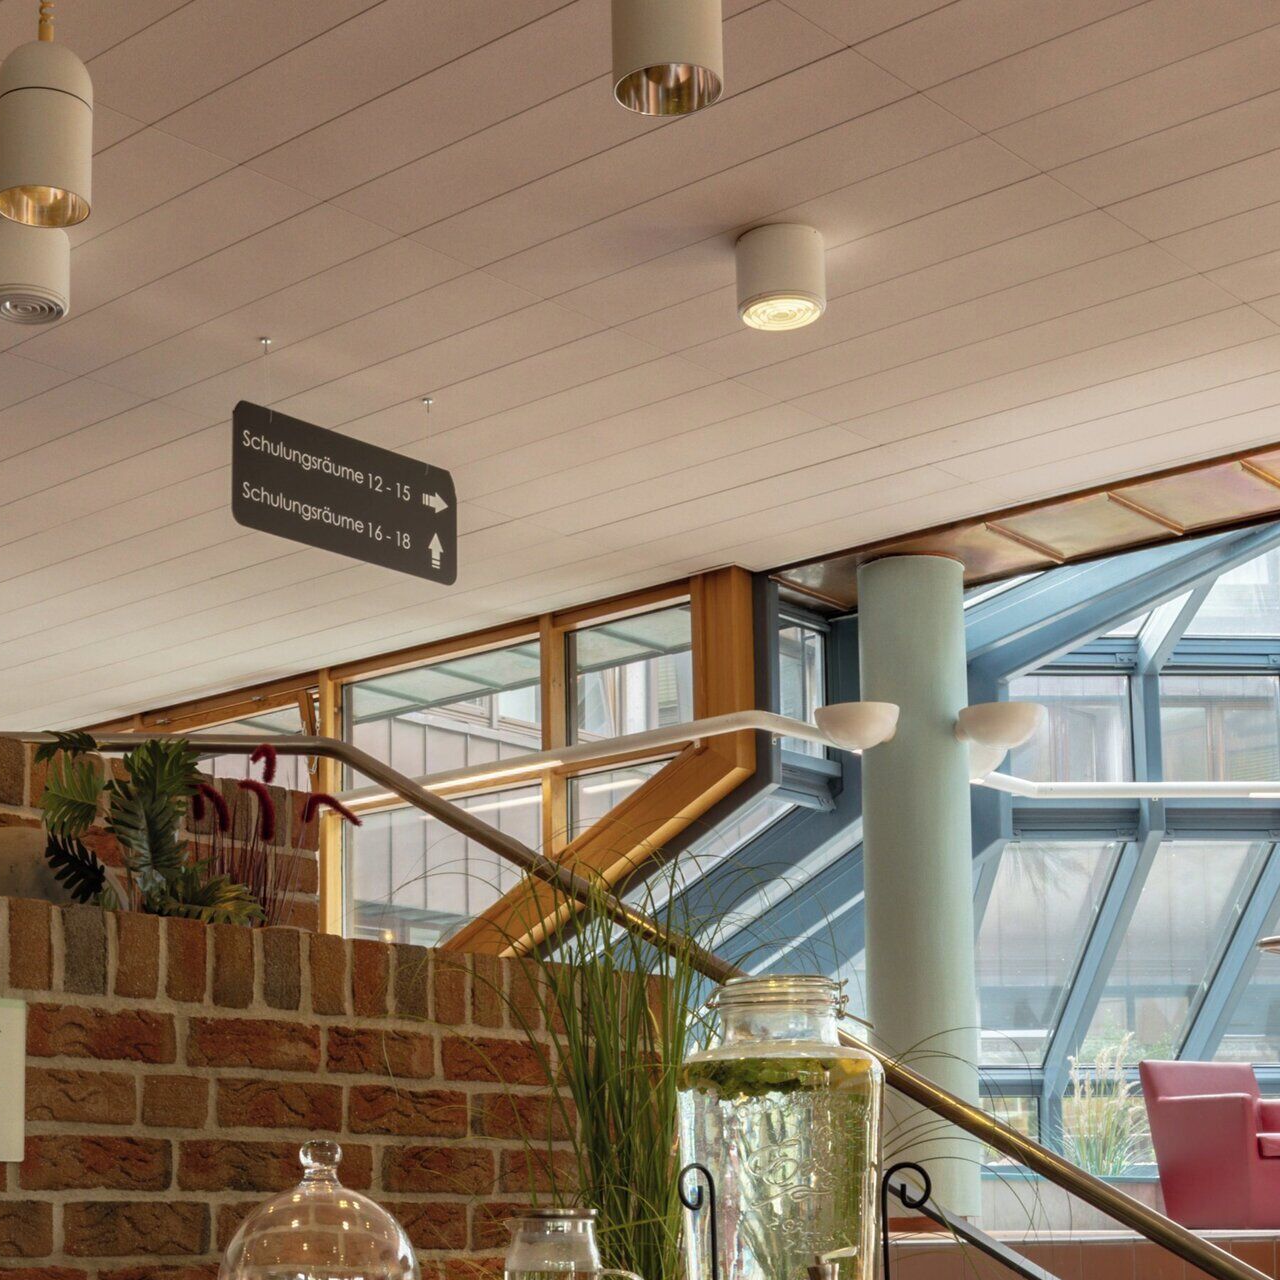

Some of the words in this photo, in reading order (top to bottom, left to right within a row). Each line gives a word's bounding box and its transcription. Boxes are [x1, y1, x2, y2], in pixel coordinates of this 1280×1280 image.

[243, 430, 364, 485] Schulungsräume
[367, 473, 383, 493] 12
[396, 482, 411, 501] 15
[243, 481, 364, 534] Schulungsräume
[367, 522, 382, 542] 16
[396, 531, 411, 550] 18
